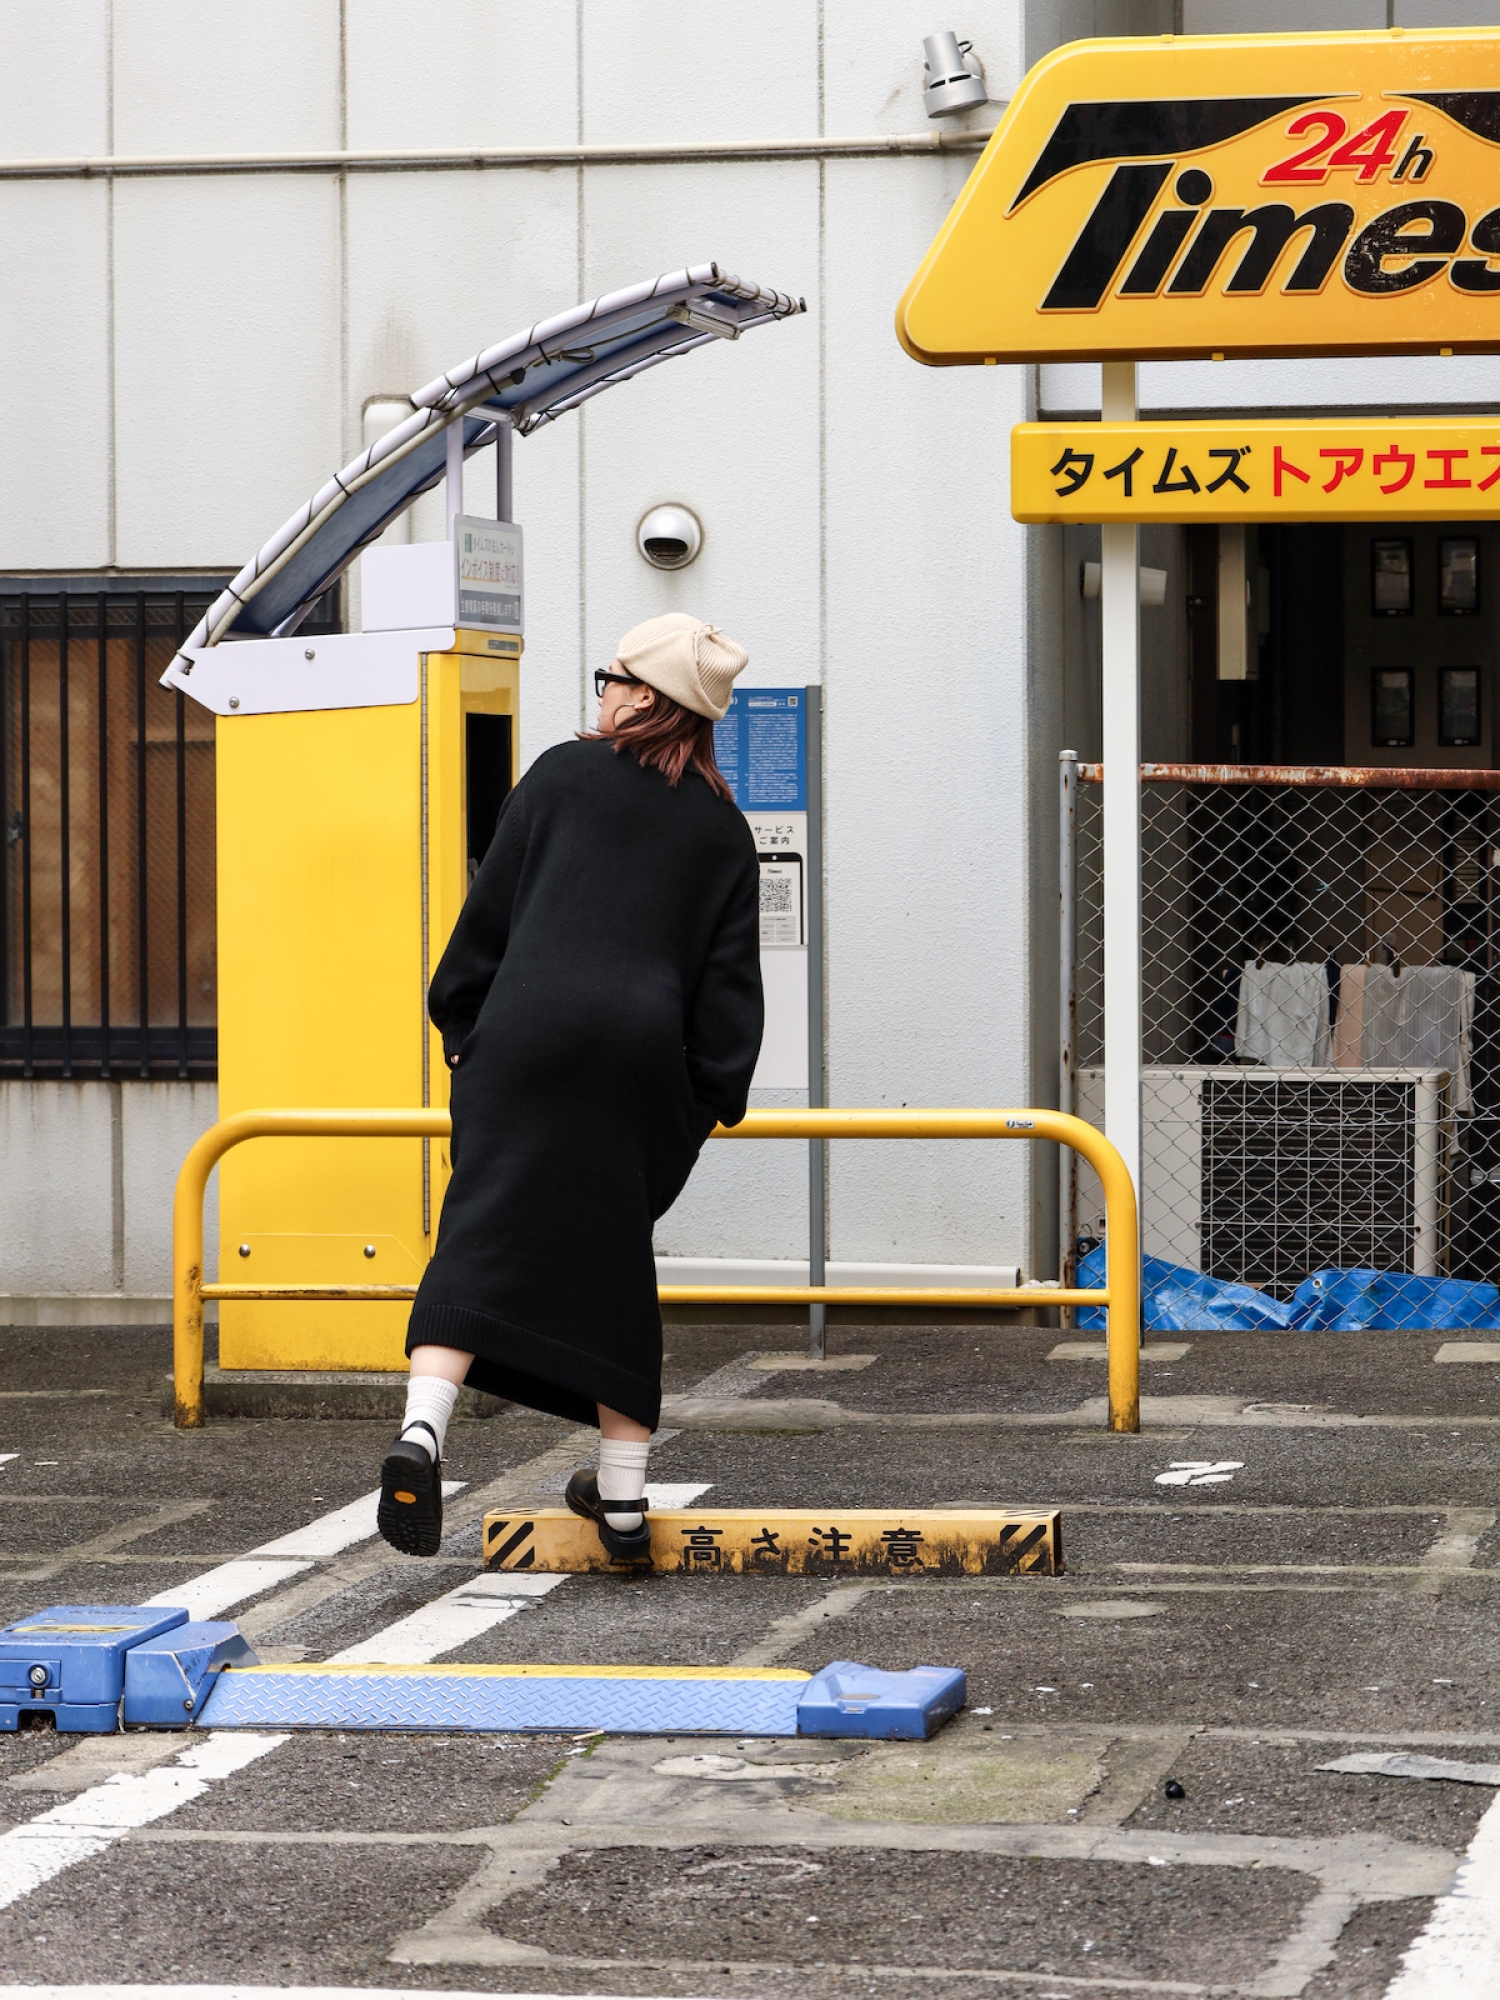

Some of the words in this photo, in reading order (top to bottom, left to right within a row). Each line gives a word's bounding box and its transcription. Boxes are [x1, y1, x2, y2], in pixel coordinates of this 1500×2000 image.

[1263, 110, 1432, 183] 24h
[1050, 445, 1251, 497] タイムズ
[754, 825, 795, 835] サービス
[759, 836, 790, 846] ご案内
[681, 1525, 926, 1570] 高さ注意
